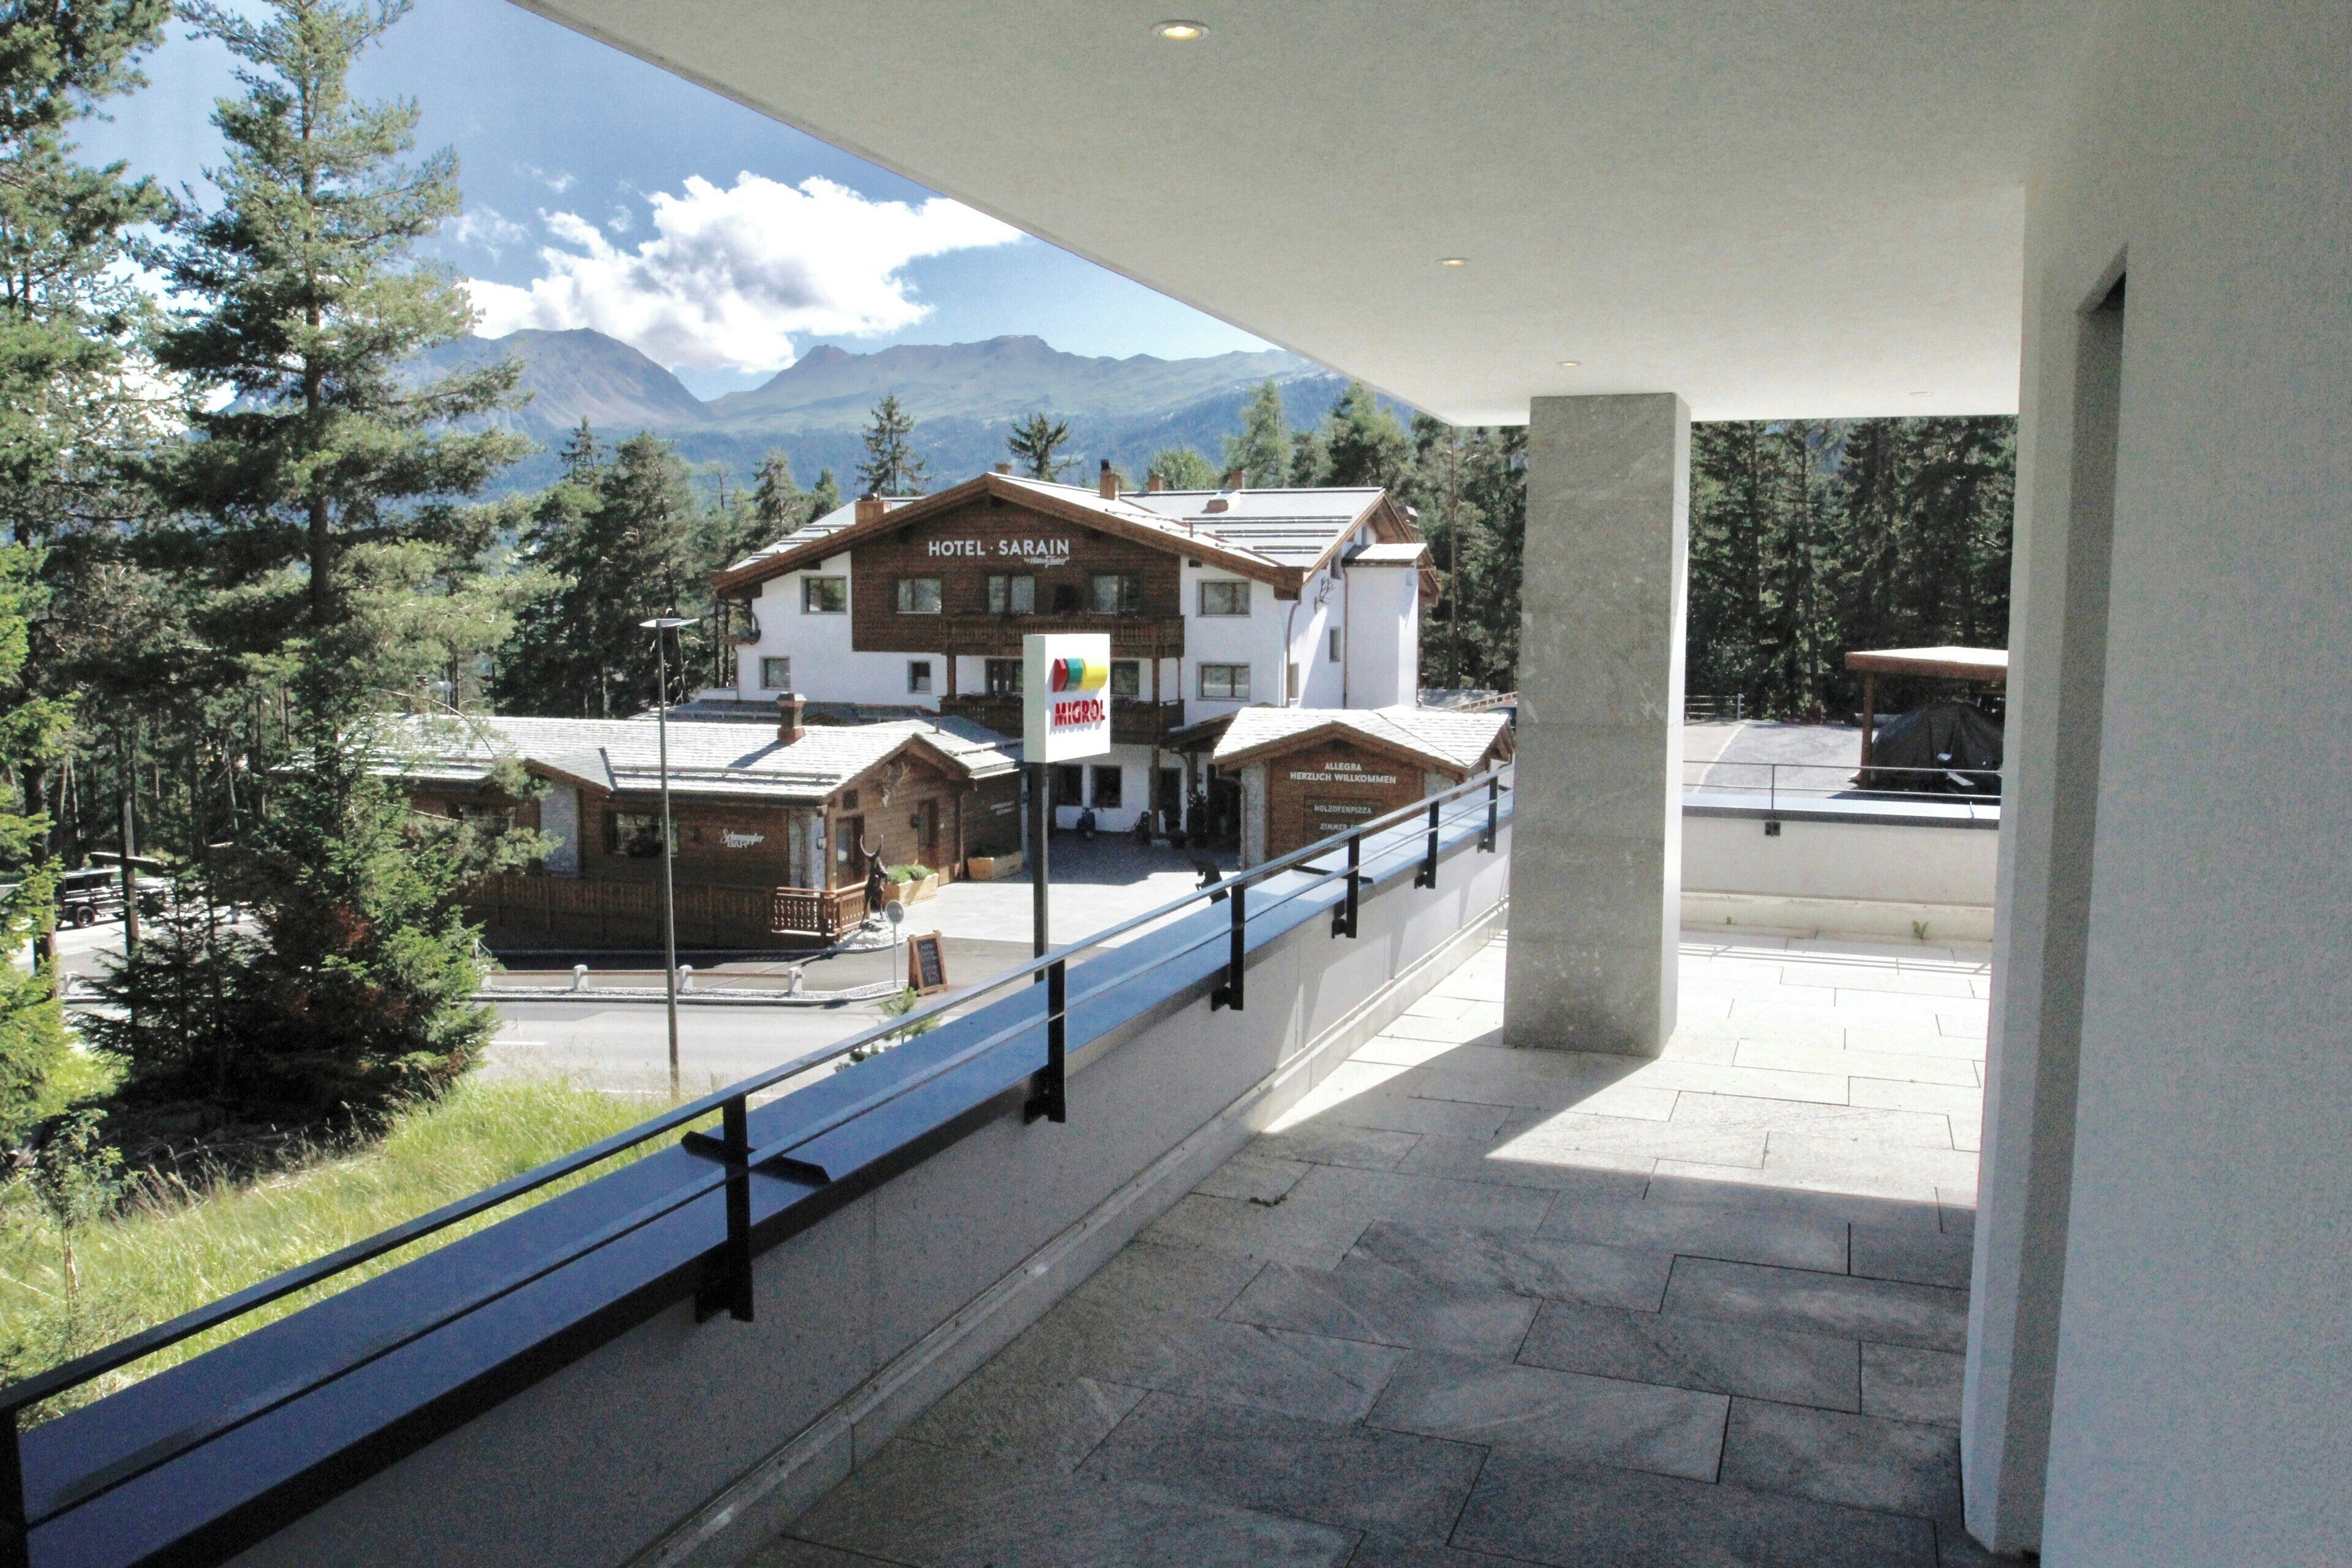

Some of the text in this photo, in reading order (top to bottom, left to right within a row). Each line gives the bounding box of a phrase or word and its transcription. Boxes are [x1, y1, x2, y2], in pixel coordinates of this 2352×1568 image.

[929, 539, 1069, 556] HOTEL SARAIN
[1054, 699, 1106, 726] MIGROL
[1324, 762, 1362, 771] ALLEGRA
[1290, 771, 1396, 784] HERZLICH WILLKOMMEN
[1314, 805, 1372, 814] HOLZOFENPIZZA
